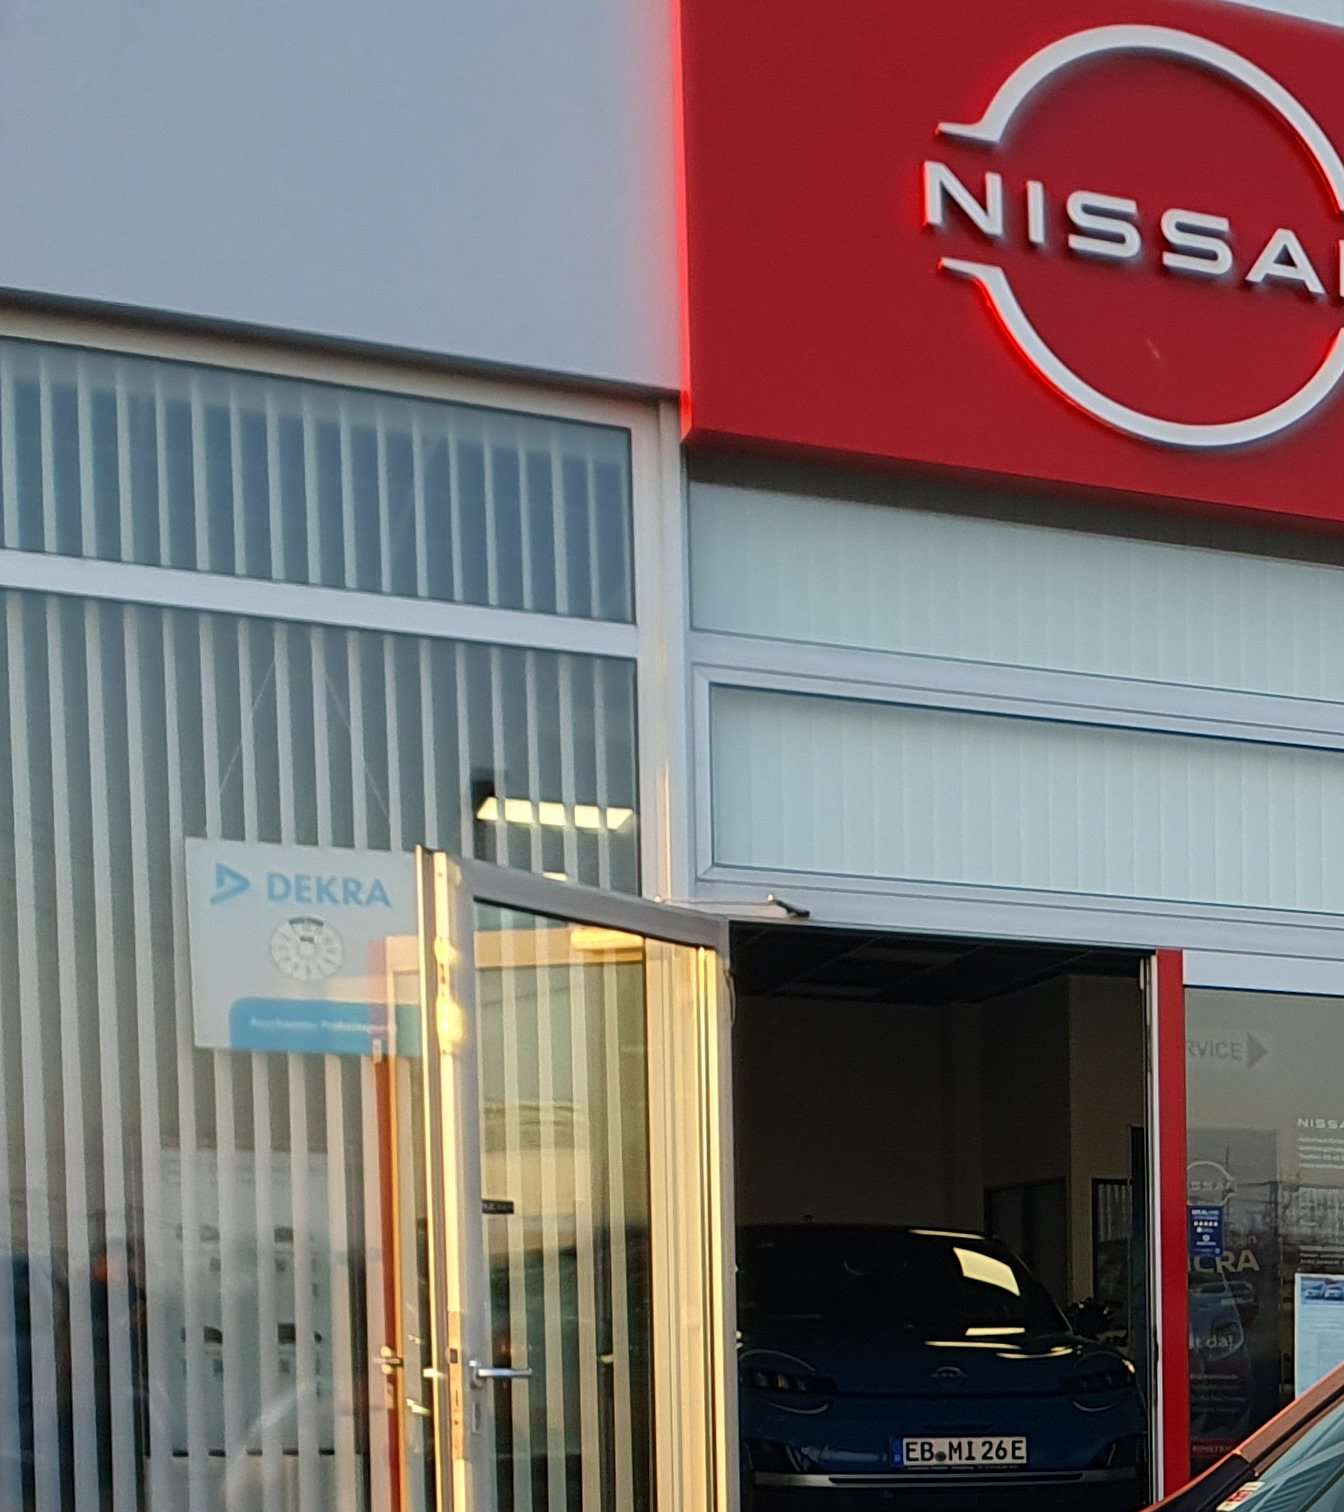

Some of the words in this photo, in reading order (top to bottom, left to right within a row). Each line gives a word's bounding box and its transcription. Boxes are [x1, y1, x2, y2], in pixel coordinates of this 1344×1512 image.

[266, 872, 392, 909] DEKRA
[905, 1441, 934, 1462] EB
[948, 1440, 976, 1461] MI
